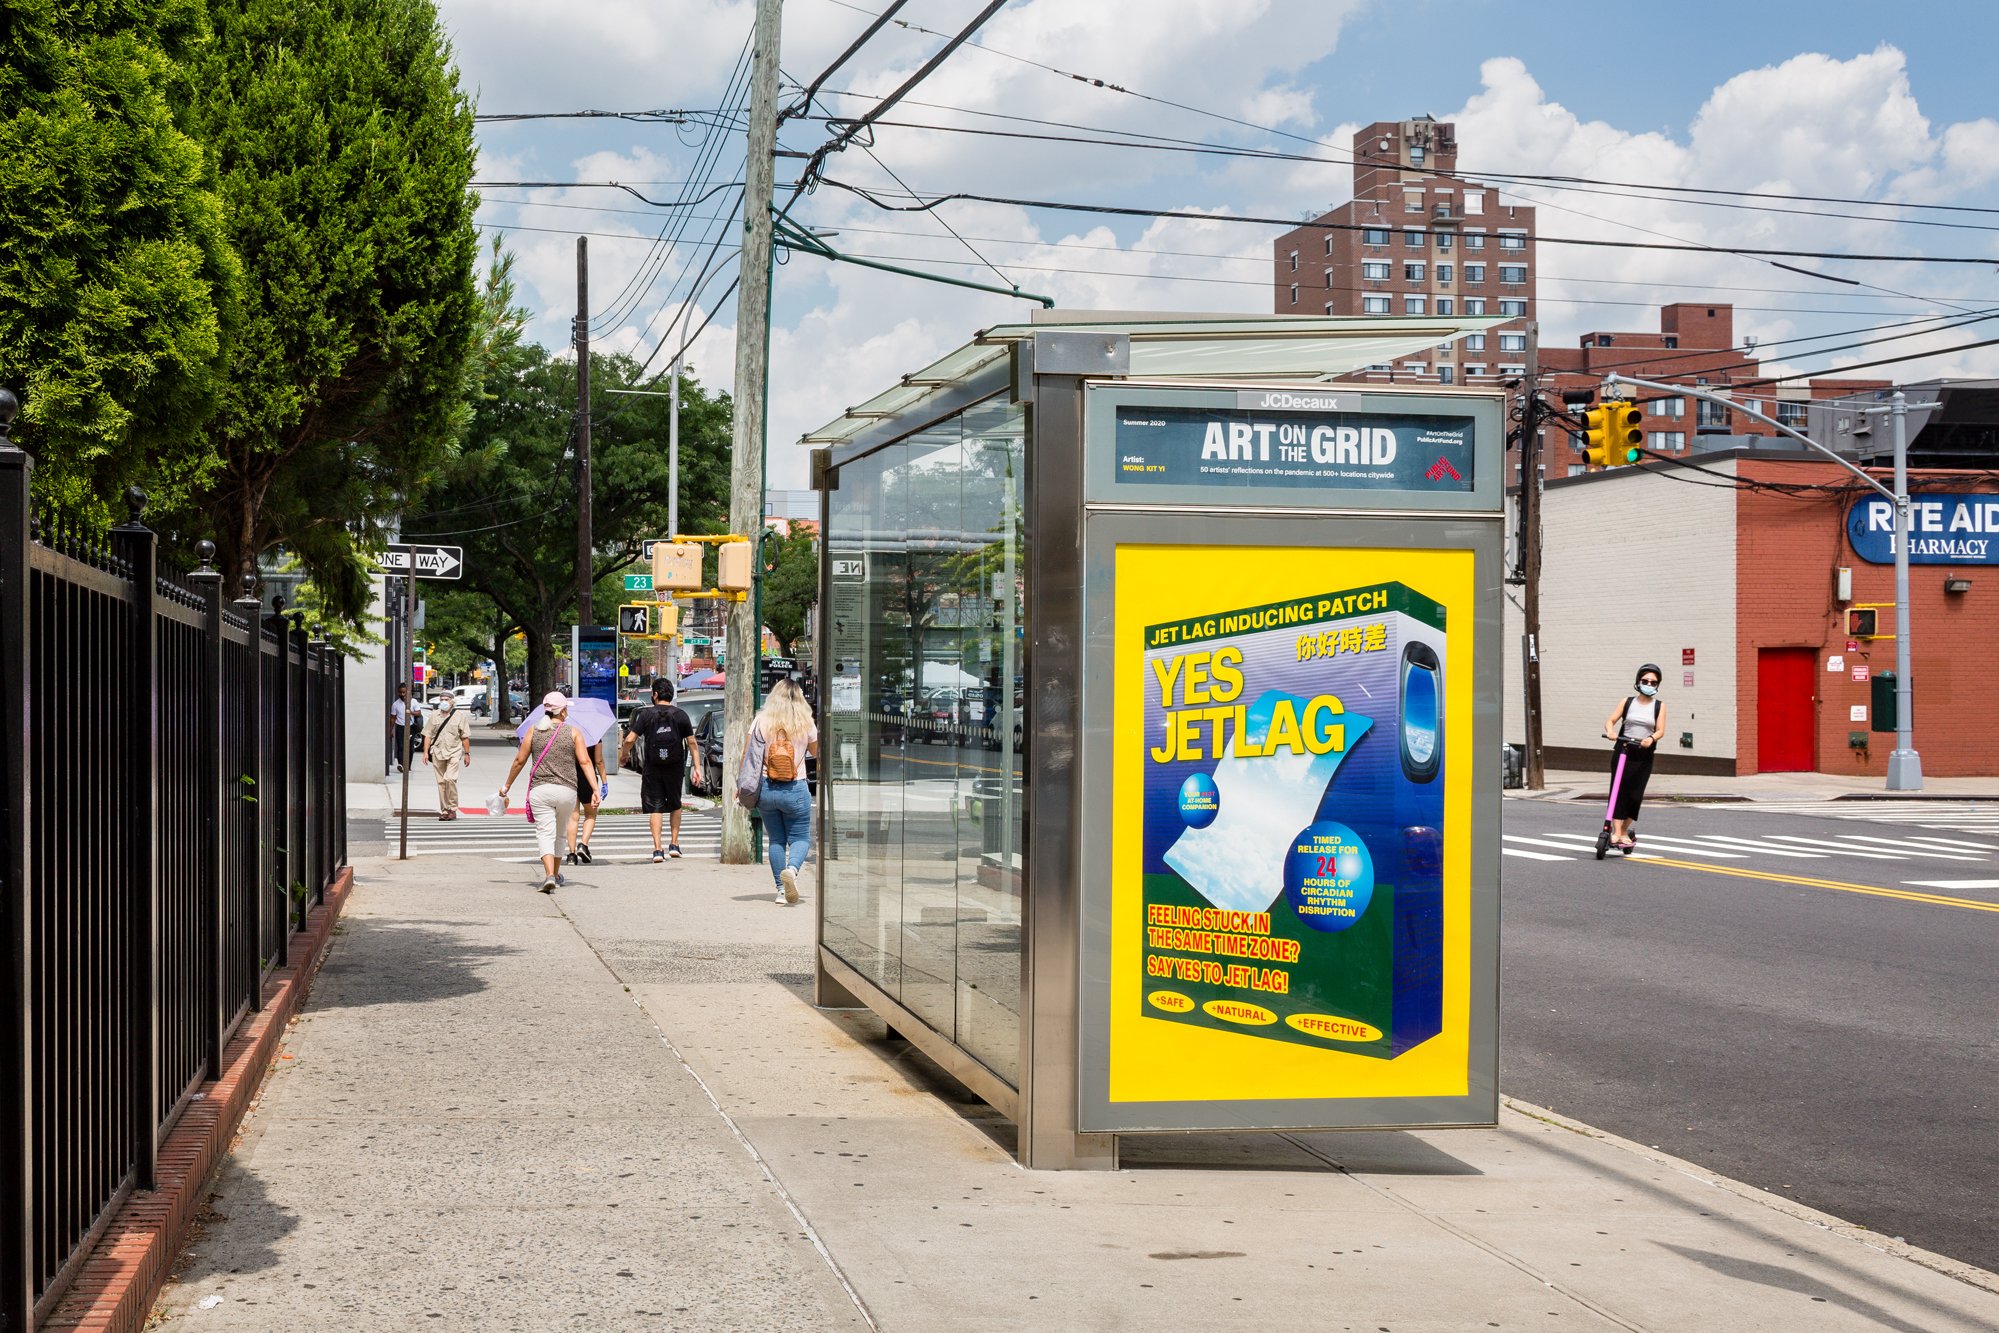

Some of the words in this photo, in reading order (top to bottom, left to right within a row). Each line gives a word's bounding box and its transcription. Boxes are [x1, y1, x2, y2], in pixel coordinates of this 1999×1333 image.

[1261, 394, 1337, 410] JCDecaux
[1201, 422, 1277, 461] ART
[1279, 424, 1306, 445] ON
[1417, 436, 1463, 446] PublicArtFund.org
[1278, 446, 1307, 462] THE
[1311, 425, 1397, 466] GRID
[1368, 471, 1394, 479] citywide
[1425, 456, 1447, 480] PUBLIC
[1434, 467, 1448, 482] ART
[1445, 462, 1461, 482] FUND
[1949, 503, 1999, 532] AID
[376, 554, 402, 566] ONE
[419, 556, 448, 568] WAY
[634, 577, 646, 588] 23
[1151, 626, 1178, 646] JET
[1182, 620, 1216, 640] LAG
[1220, 603, 1313, 634] INDUCING
[1318, 590, 1388, 618] PATCH
[1296, 622, 1387, 661] 你好時差
[1151, 646, 1244, 708] YES
[1151, 694, 1344, 764] JETLAG
[1298, 845, 1336, 853] RELEASE
[1339, 846, 1358, 854] FOR
[1313, 836, 1341, 844] TIMED
[1317, 856, 1336, 877] 24
[1301, 887, 1353, 897] CIRCADIAN
[1304, 878, 1336, 887] HOURS
[1308, 897, 1346, 906] RHYTHM
[1148, 904, 1201, 928] FEELING
[1202, 908, 1251, 933] STUCK
[1253, 912, 1270, 935] IN
[1299, 906, 1355, 917] DISRUPTION
[1148, 926, 1173, 949] THE
[1174, 929, 1213, 953] SAME
[1214, 933, 1248, 957] TIME
[1249, 936, 1300, 963] ZONE?
[1148, 955, 1174, 978] SAY
[1175, 958, 1202, 982] YES
[1202, 961, 1223, 984] TO
[1224, 964, 1251, 988] JET
[1252, 967, 1288, 994] LAG!
[1156, 996, 1184, 1008] +SAFE
[1212, 1004, 1267, 1022] +NATURAL
[1297, 1018, 1367, 1038] +EFFECTIVE
